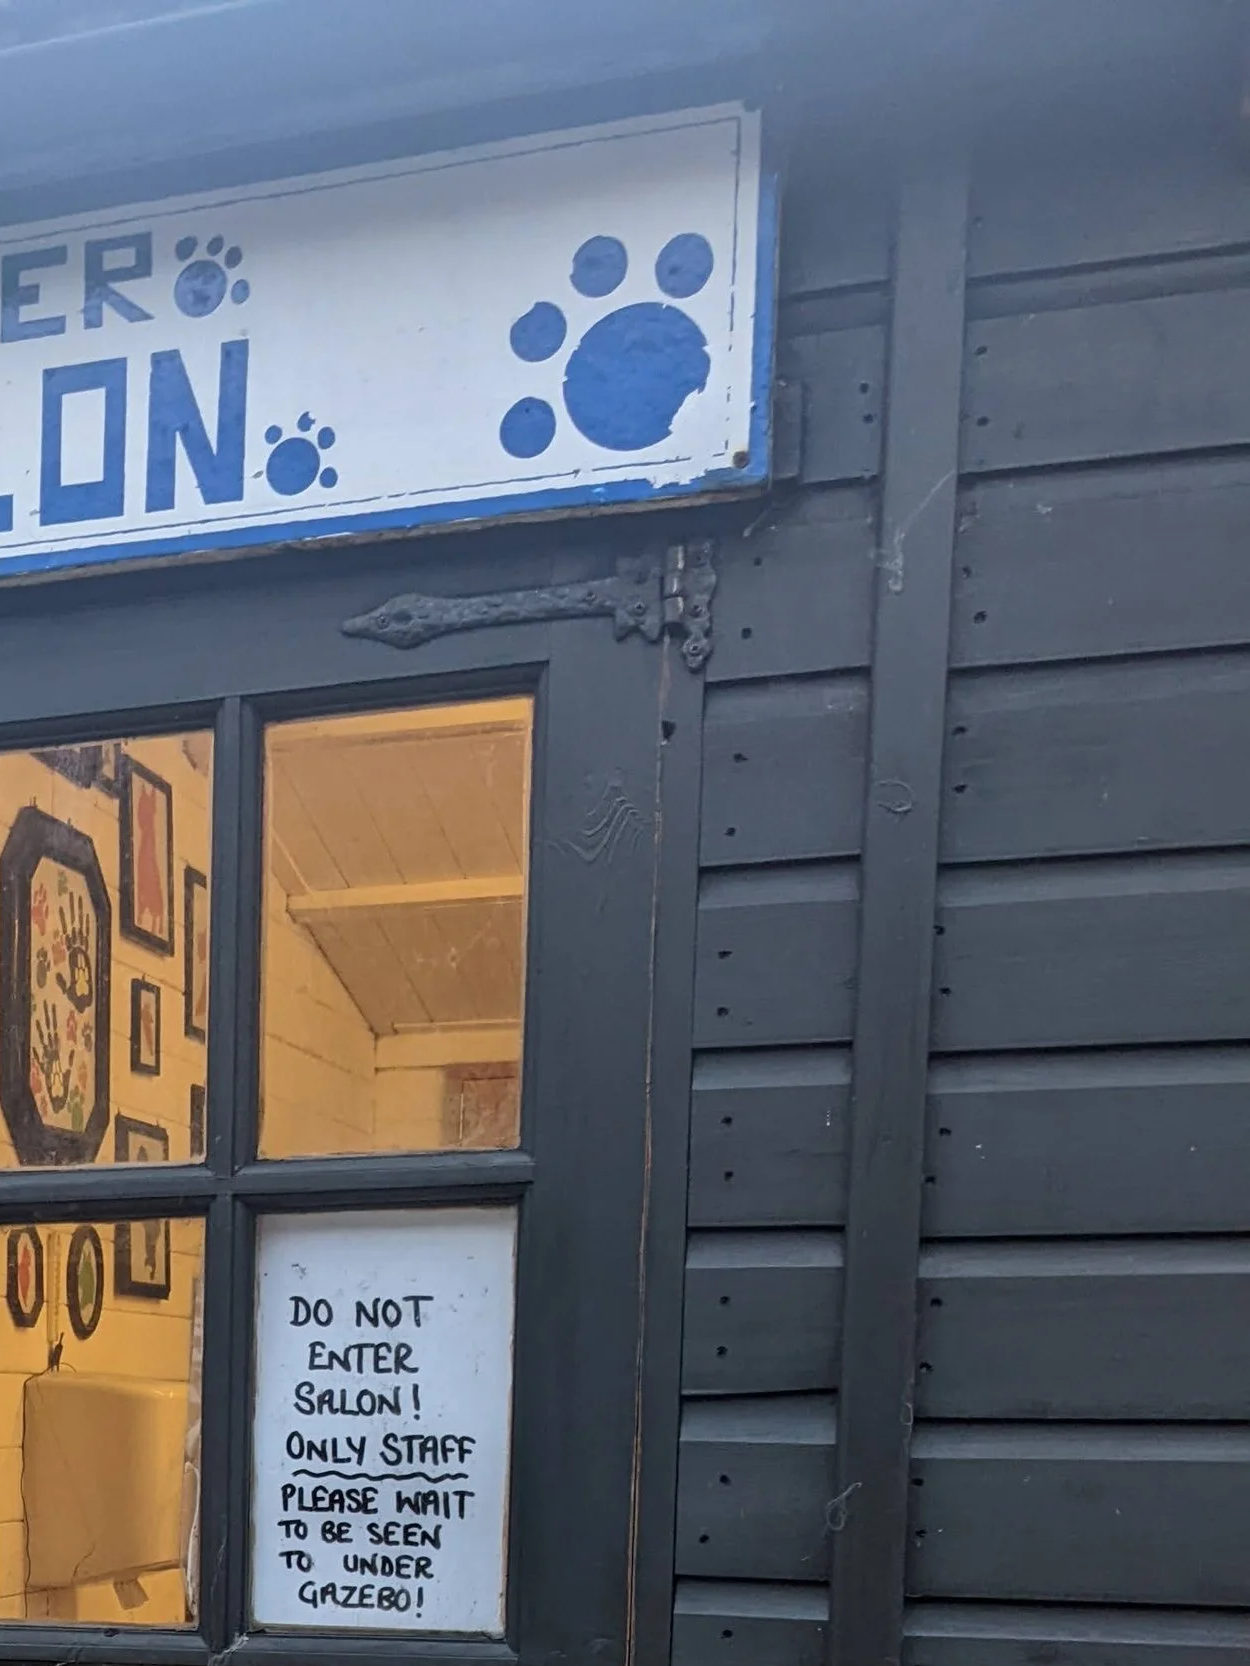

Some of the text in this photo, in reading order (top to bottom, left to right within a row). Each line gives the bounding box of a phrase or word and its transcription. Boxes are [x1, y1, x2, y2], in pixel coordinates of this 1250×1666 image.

[289, 1295, 434, 1329] DO NOT
[308, 1340, 419, 1375] ENTER
[293, 1381, 421, 1421] SALON!
[286, 1430, 476, 1467] ONLY STAFF
[280, 1483, 476, 1520] PLEASE WAIT
[277, 1519, 443, 1551] TO BE SEEN
[278, 1550, 435, 1580] TO UNDER
[298, 1580, 425, 1618] GAZEBO!
